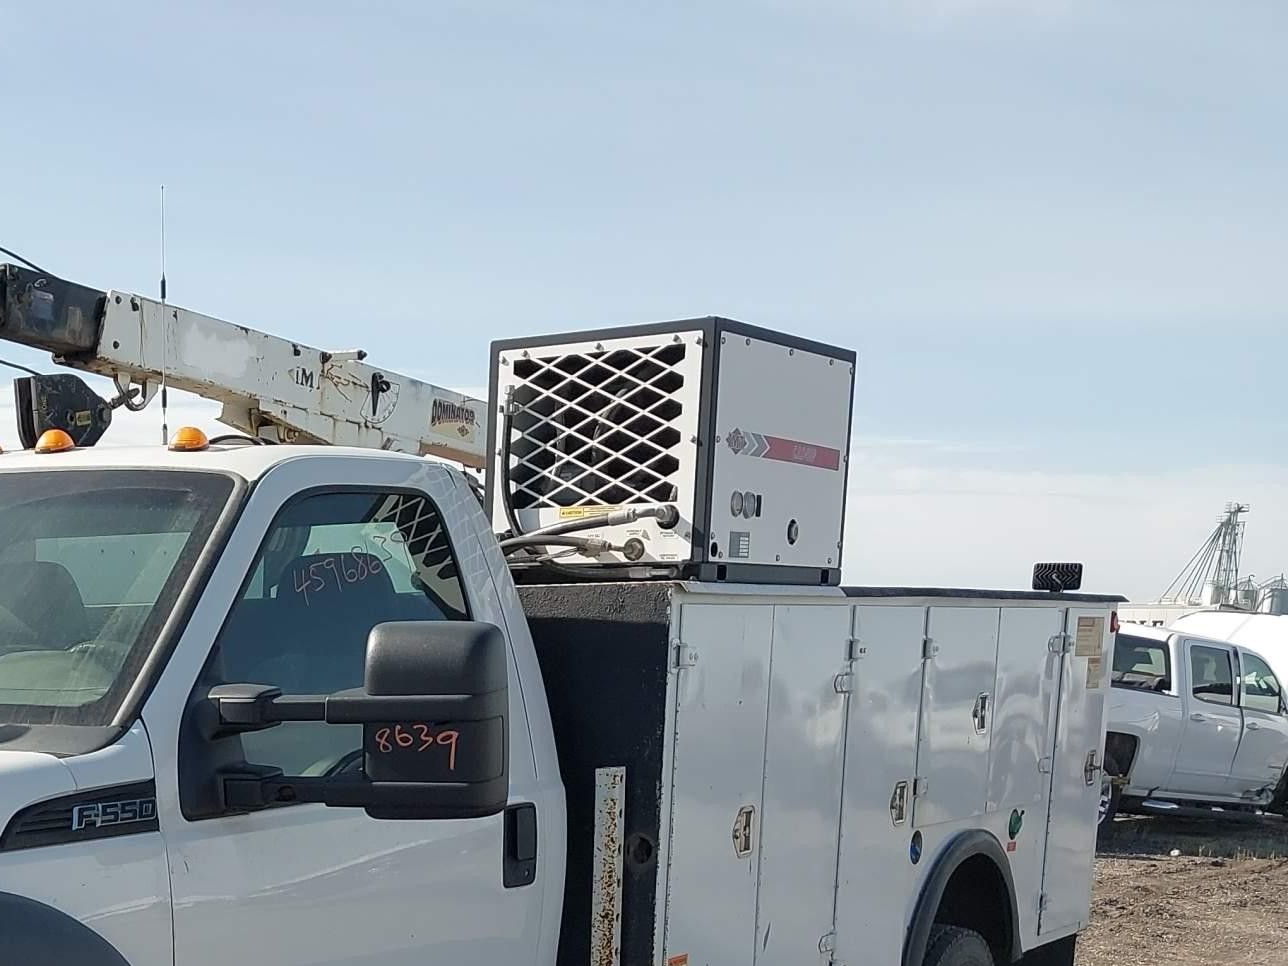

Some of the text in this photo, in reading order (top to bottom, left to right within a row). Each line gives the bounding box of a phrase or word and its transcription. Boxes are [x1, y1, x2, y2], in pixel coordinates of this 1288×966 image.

[431, 398, 475, 427] DOMINATOR
[293, 530, 413, 607] 45968639
[375, 724, 459, 771] 8639
